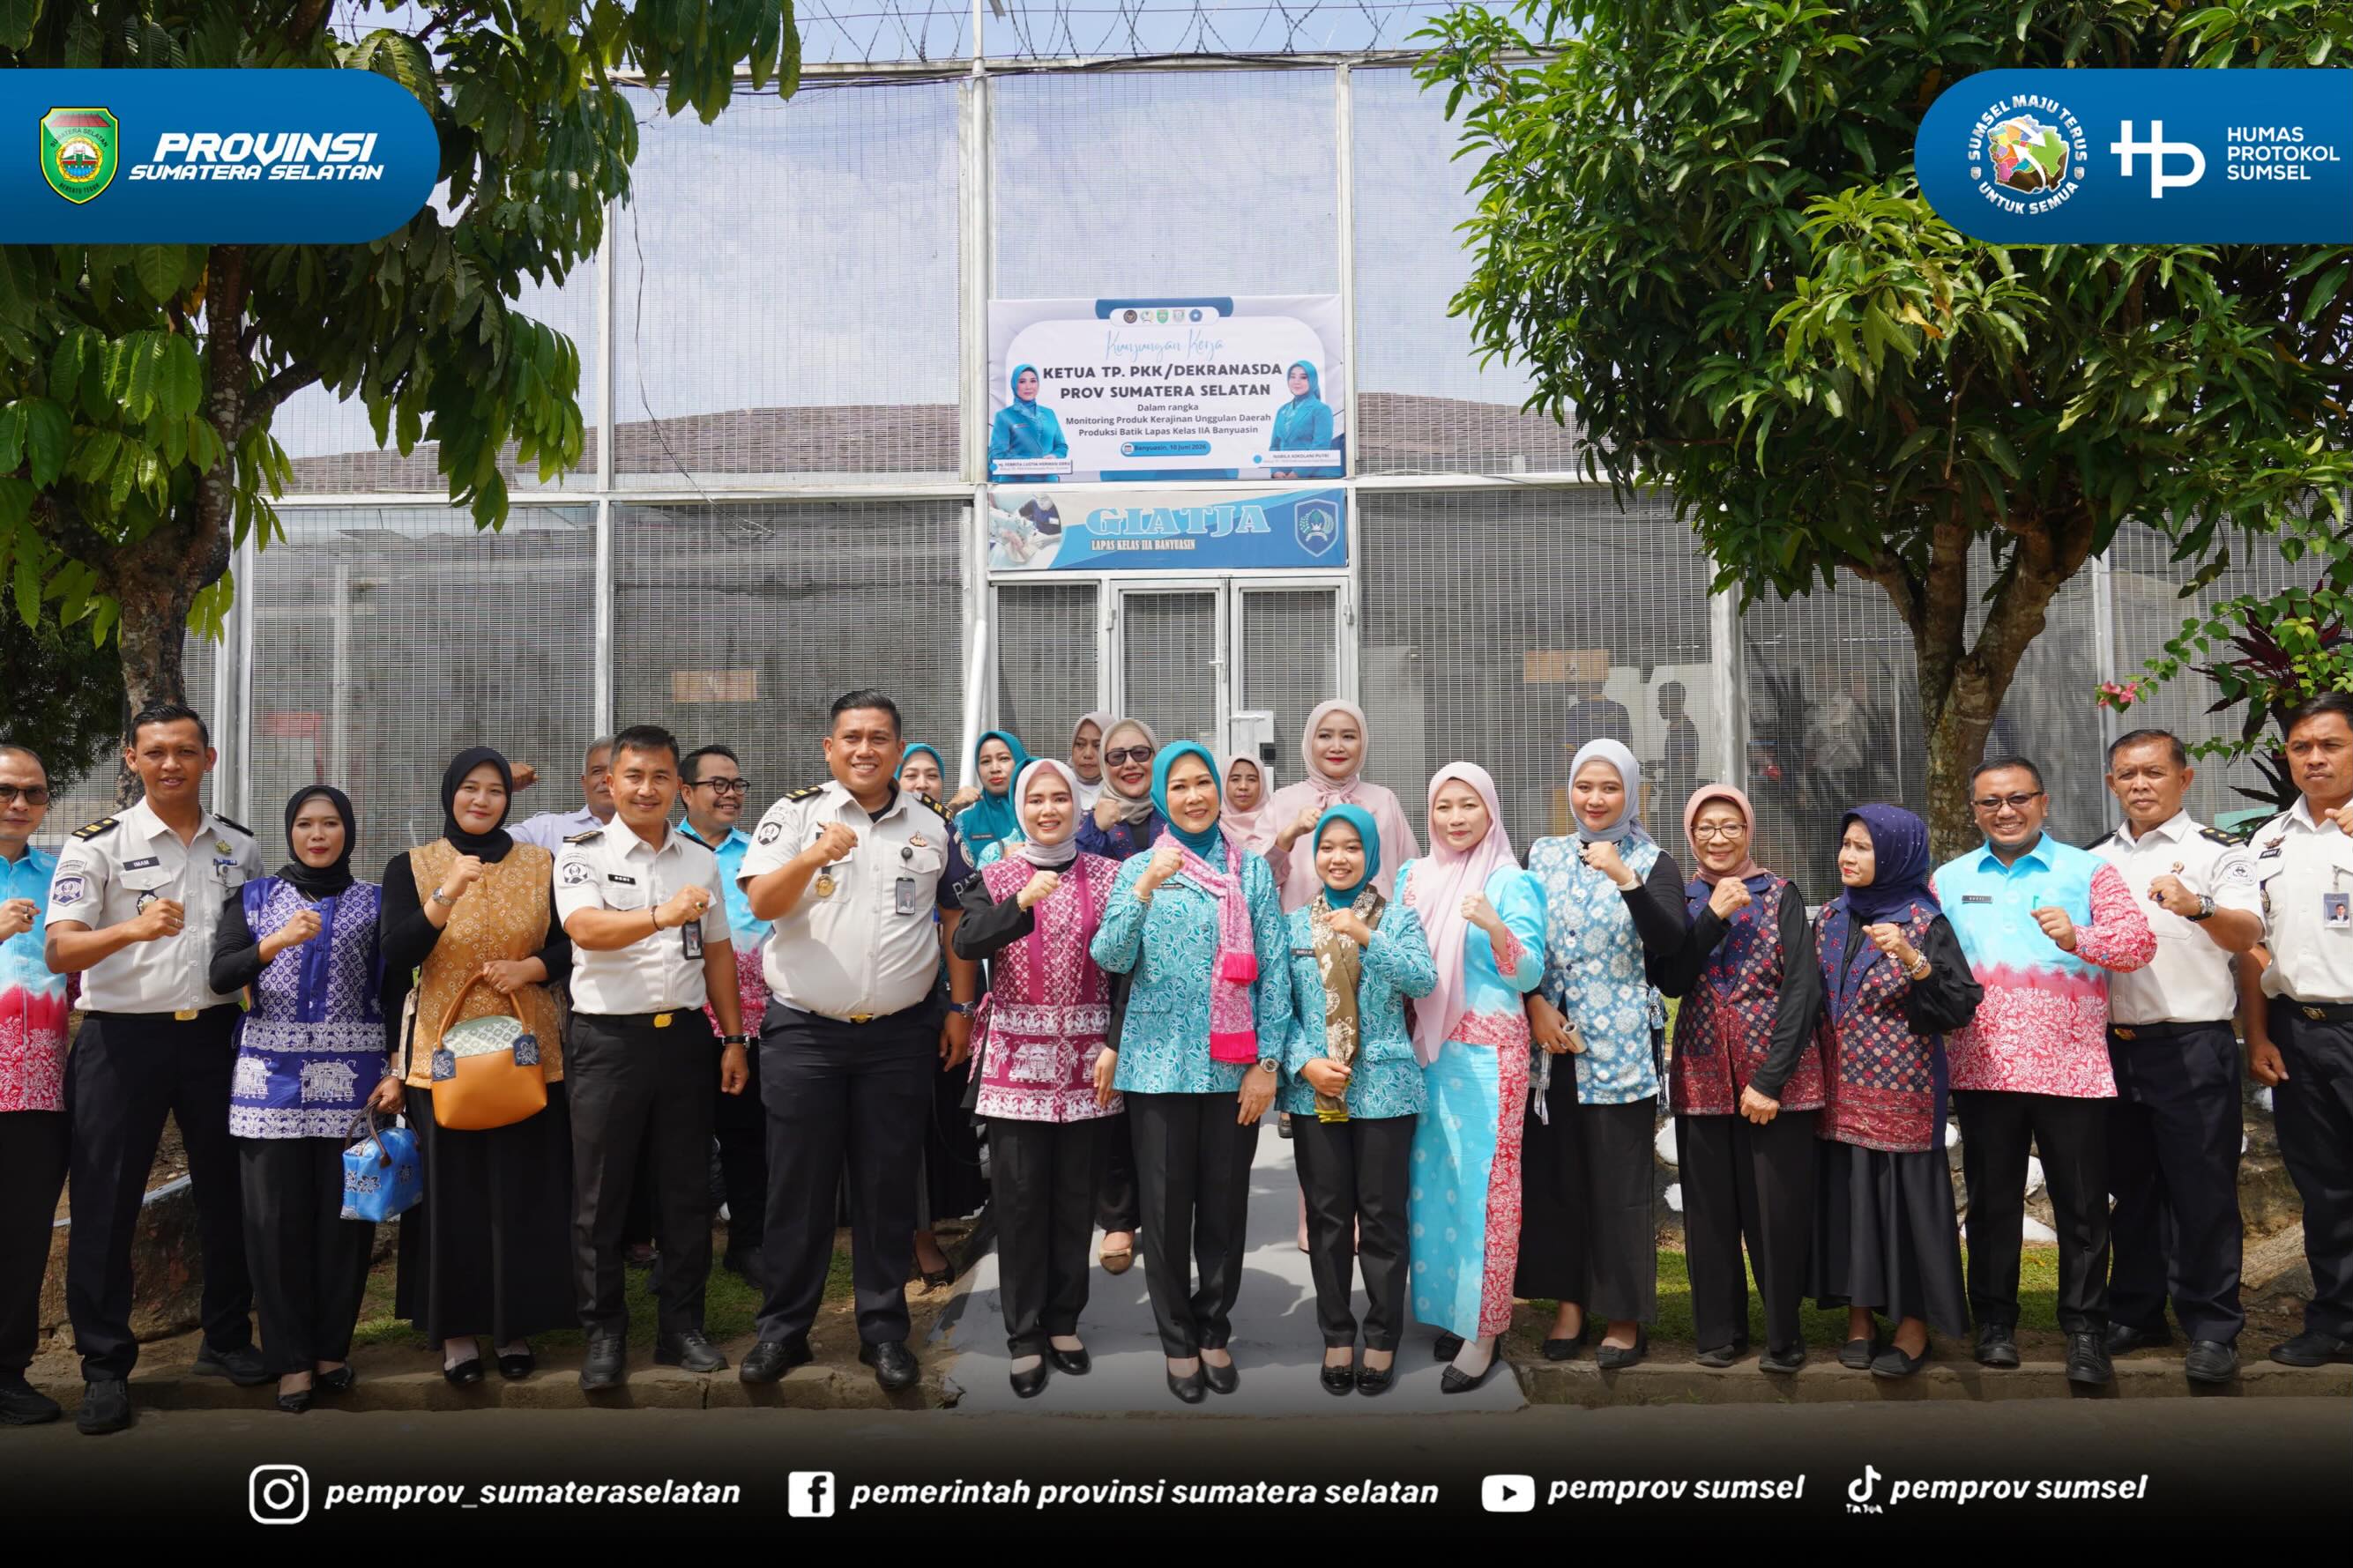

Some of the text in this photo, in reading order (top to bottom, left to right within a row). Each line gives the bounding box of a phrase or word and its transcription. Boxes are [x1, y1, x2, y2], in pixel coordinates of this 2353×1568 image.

[1106, 329, 1225, 363] Kunjungan Kerja
[1043, 363, 1283, 380] KETUA TP. PKK/DEKRANASDA
[1061, 383, 1271, 399] PROV SUMATERA SELATAN
[1137, 403, 1199, 414] Dalam rangka
[1066, 412, 1271, 427] Monitoring Produk Kerajinan Unggulan Daerah
[1078, 427, 1118, 437] Produksi
[1120, 427, 1143, 436] Batik
[1144, 427, 1171, 437] Lapas
[1173, 426, 1196, 435] Kelas
[1212, 425, 1259, 435] Banyuasin
[1085, 505, 1271, 538] GIATJA
[1091, 540, 1115, 551] LAPAS
[1117, 540, 1139, 551] KELAS
[1155, 539, 1195, 550] BANYUASIN
